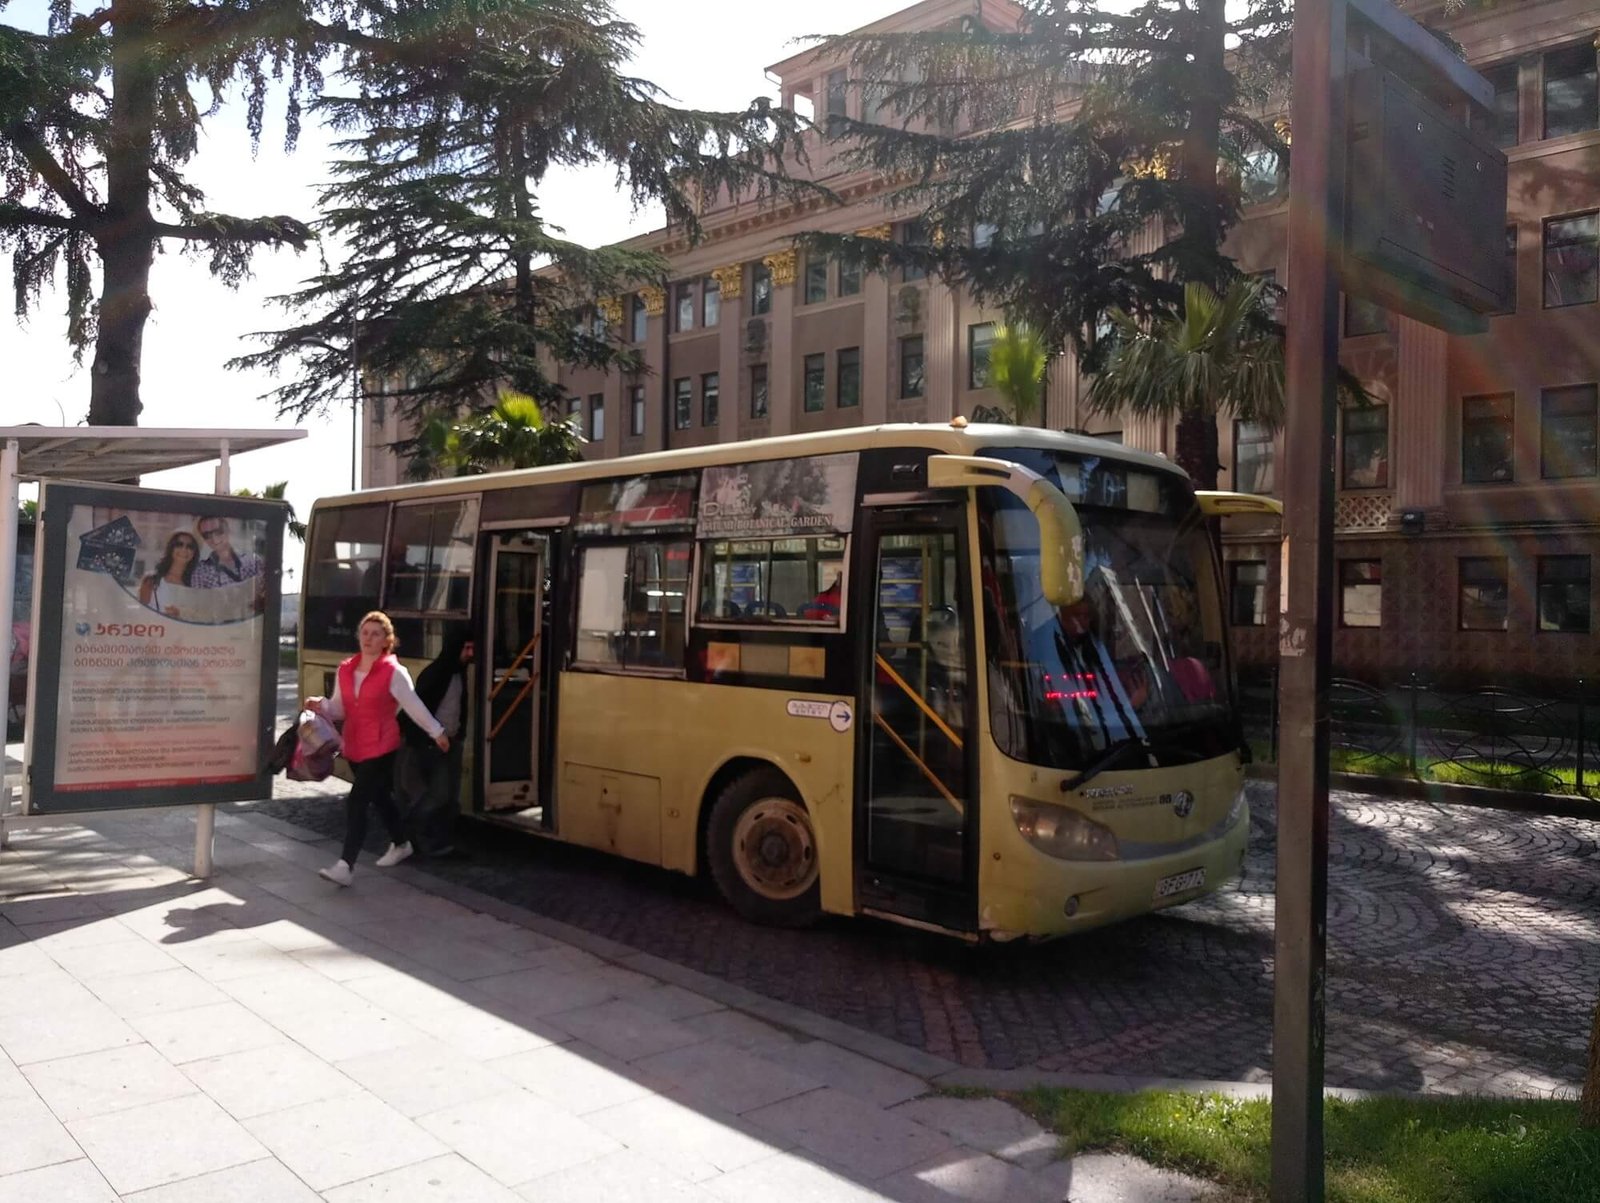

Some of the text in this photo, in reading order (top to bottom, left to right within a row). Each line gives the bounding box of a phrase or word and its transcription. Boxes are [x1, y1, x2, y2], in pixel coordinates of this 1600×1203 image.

[737, 517, 787, 530] BOTANICAL
[790, 515, 833, 528] GARDEN
[95, 623, 165, 638] კრედო
